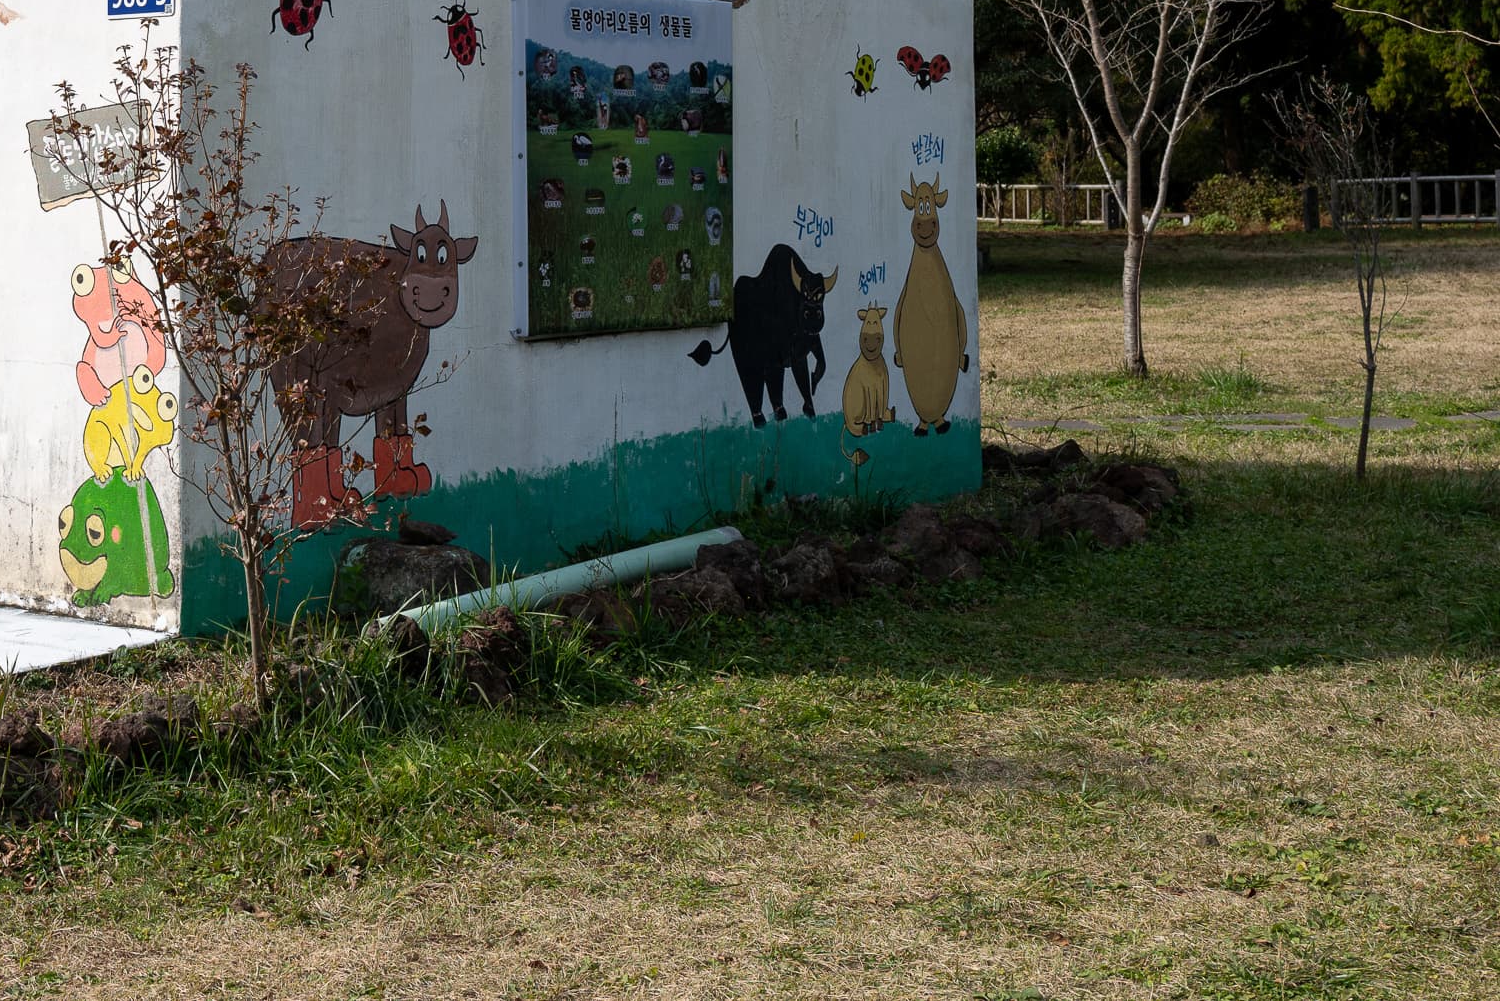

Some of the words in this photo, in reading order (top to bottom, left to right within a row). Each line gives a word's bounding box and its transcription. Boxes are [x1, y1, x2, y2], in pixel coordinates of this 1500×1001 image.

[570, 8, 650, 35] 물영아리오름의
[660, 15, 692, 38] 생물들
[912, 132, 944, 166] 밭갈쇠
[793, 204, 834, 248] 부랭이
[858, 260, 886, 295] 송애기
